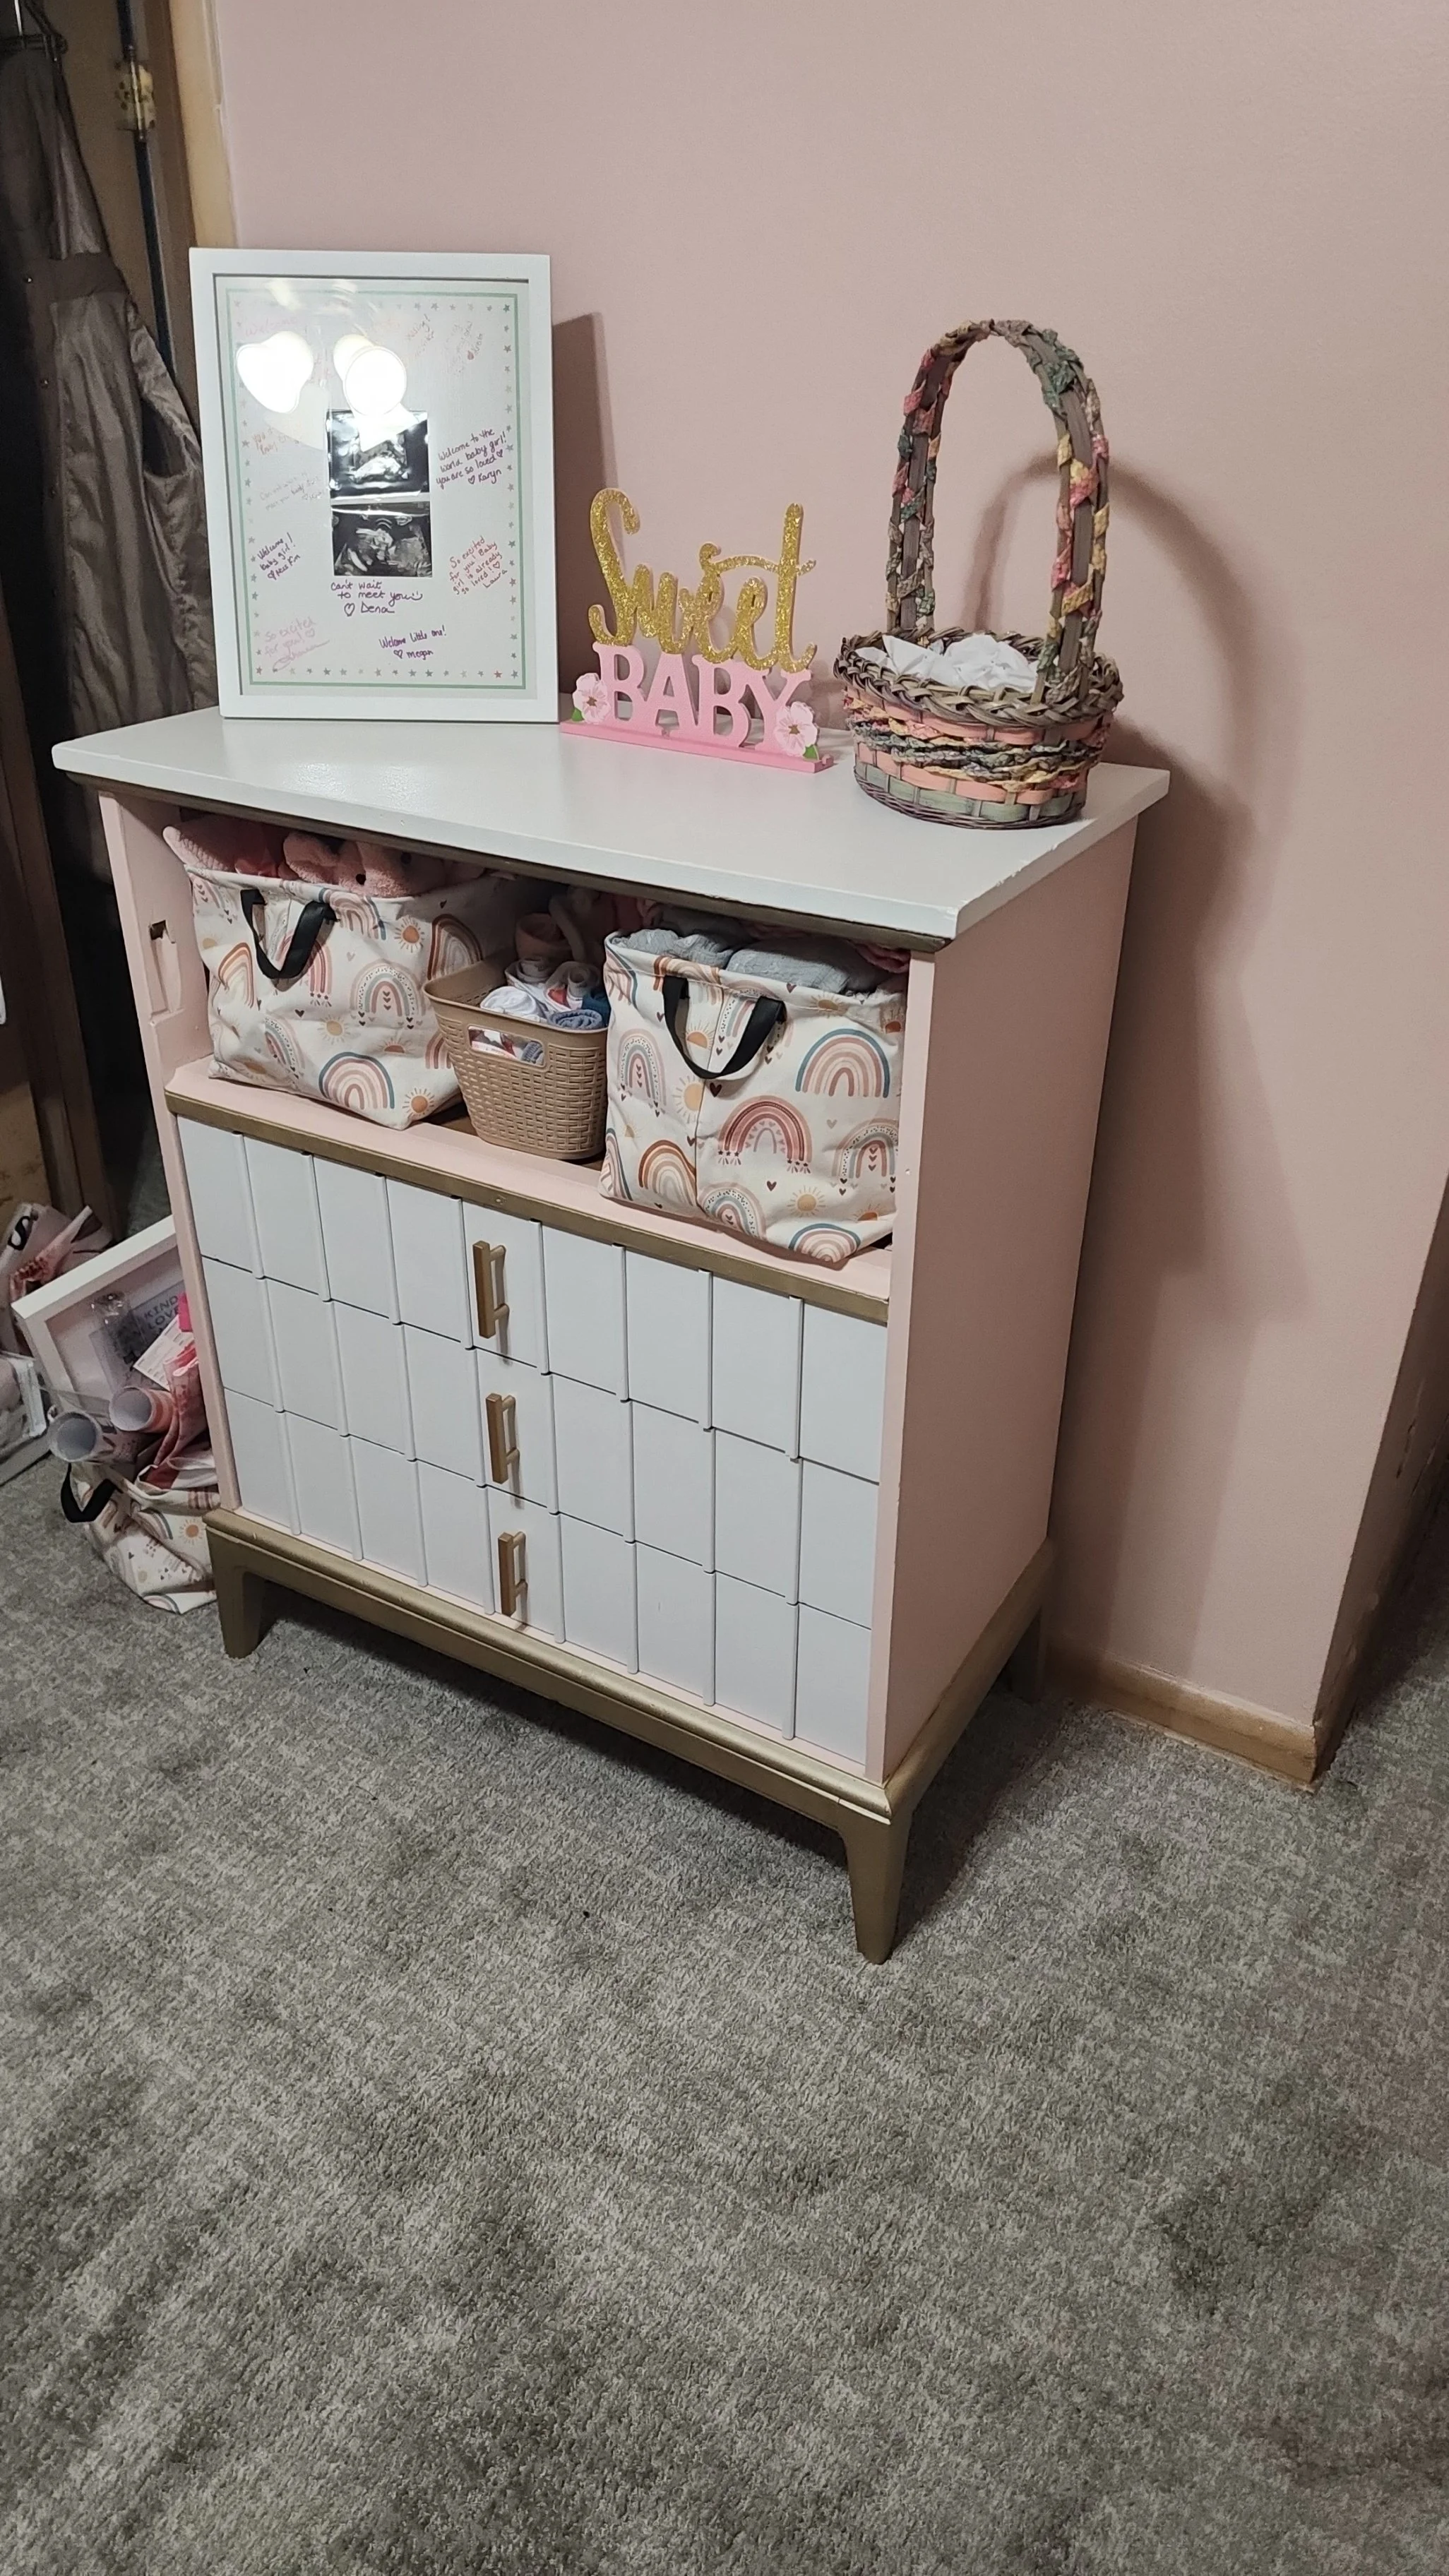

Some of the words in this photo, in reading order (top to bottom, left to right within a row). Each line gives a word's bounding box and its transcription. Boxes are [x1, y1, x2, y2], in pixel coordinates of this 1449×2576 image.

[438, 442, 470, 460] Welcome
[470, 433, 479, 443] to
[479, 429, 495, 439] the
[465, 445, 487, 460] baby
[489, 431, 506, 453] girl!
[436, 476, 451, 489] you
[451, 471, 463, 480] are
[475, 454, 496, 469] loved
[478, 469, 502, 484] Karyn
[449, 571, 460, 582] for
[478, 541, 497, 556] Baby
[449, 556, 461, 568] So
[476, 551, 502, 573] already
[358, 580, 382, 590] wait
[482, 569, 508, 588] Laura
[588, 487, 818, 674] Sweet
[358, 590, 386, 599] meet
[388, 592, 410, 607] you
[361, 601, 395, 614] Dena
[378, 636, 406, 648] Welcome
[431, 624, 446, 637] one!
[592, 641, 812, 752] BABY
[144, 1295, 179, 1319] KIND
